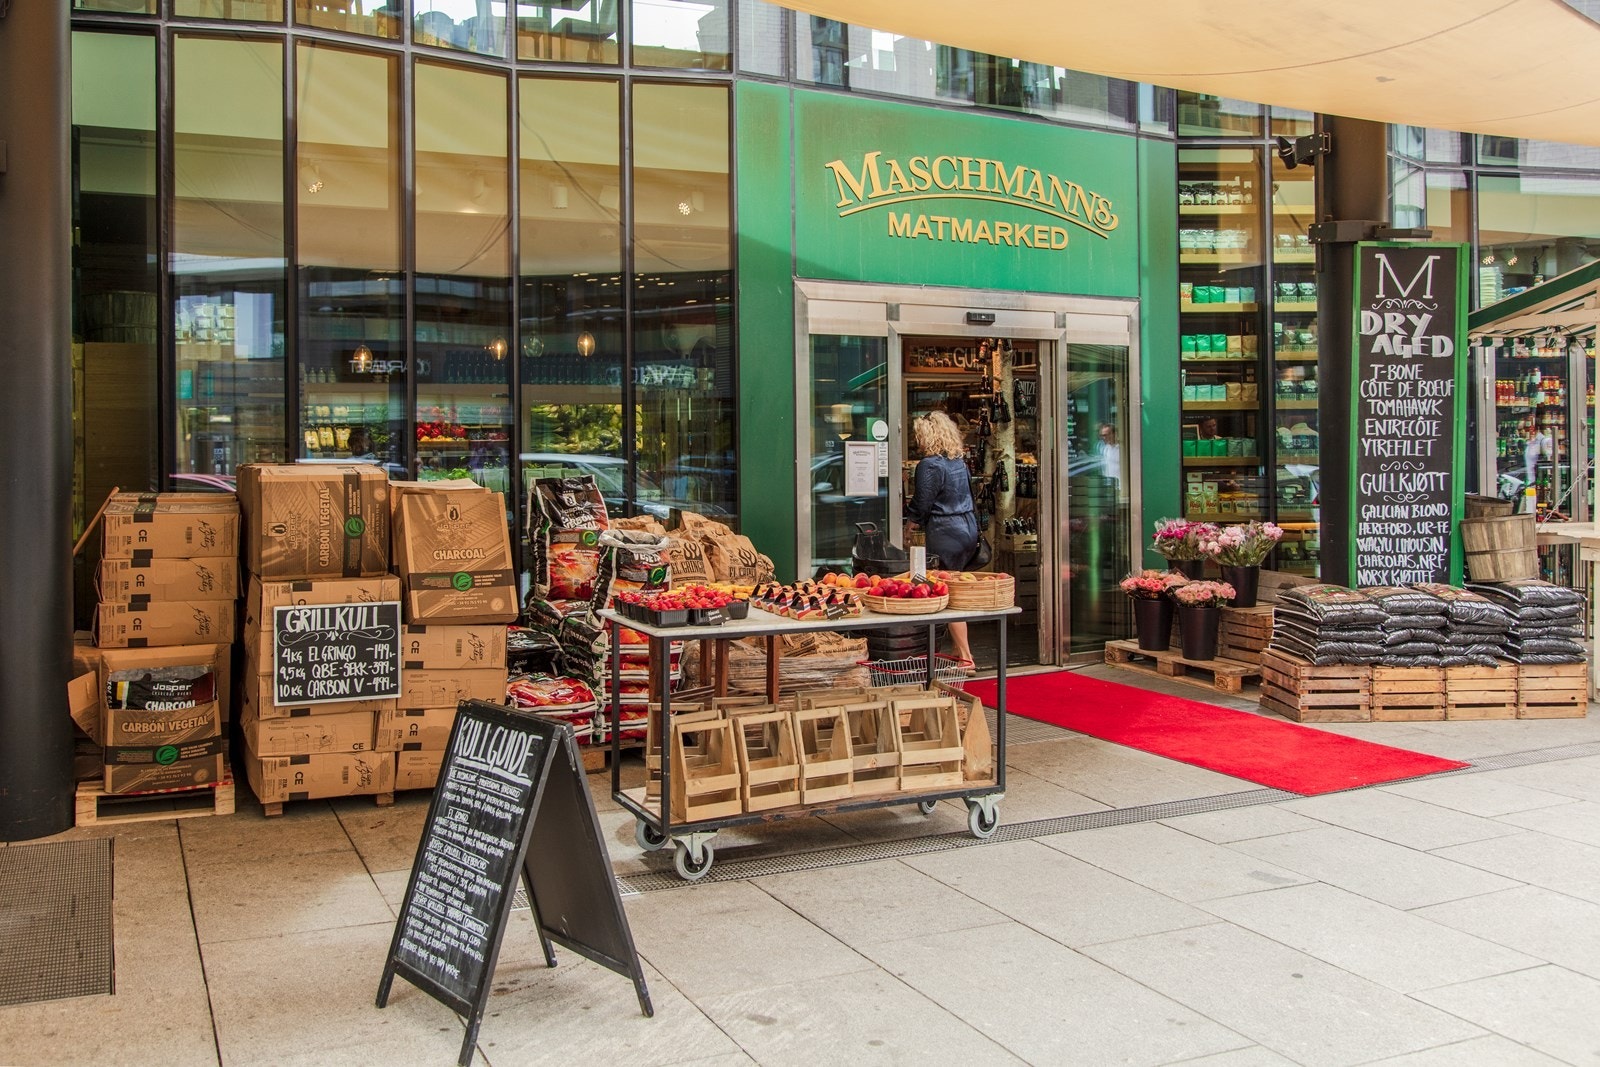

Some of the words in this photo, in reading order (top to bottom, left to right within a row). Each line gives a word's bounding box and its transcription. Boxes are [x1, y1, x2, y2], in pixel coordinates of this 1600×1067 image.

[825, 151, 1119, 231] MASCHMANNS
[887, 211, 1069, 250] MATMARKED
[1375, 253, 1440, 299] M
[1359, 310, 1433, 338] DRY
[1371, 334, 1454, 358] AGED
[1370, 364, 1424, 380] T-BONE
[1398, 381, 1414, 398] DE
[1367, 398, 1443, 418] TOMAHAWK
[1365, 416, 1442, 437] ENTRECÔTE
[1361, 438, 1438, 457] YTREFILET
[1360, 472, 1450, 496] GULLKJØTT
[320, 487, 330, 527] VEGETAL
[1361, 504, 1409, 521] GALICIAN
[433, 549, 486, 561] CHARCOAL
[1357, 569, 1389, 586] NORSK
[285, 606, 390, 633] GRILLKULL
[308, 646, 320, 662] EL
[321, 645, 356, 662] GRINGO
[307, 678, 350, 699] CARBON
[354, 678, 364, 693] V
[145, 700, 197, 712] CHARCOAL
[168, 715, 209, 732] VEGETAL
